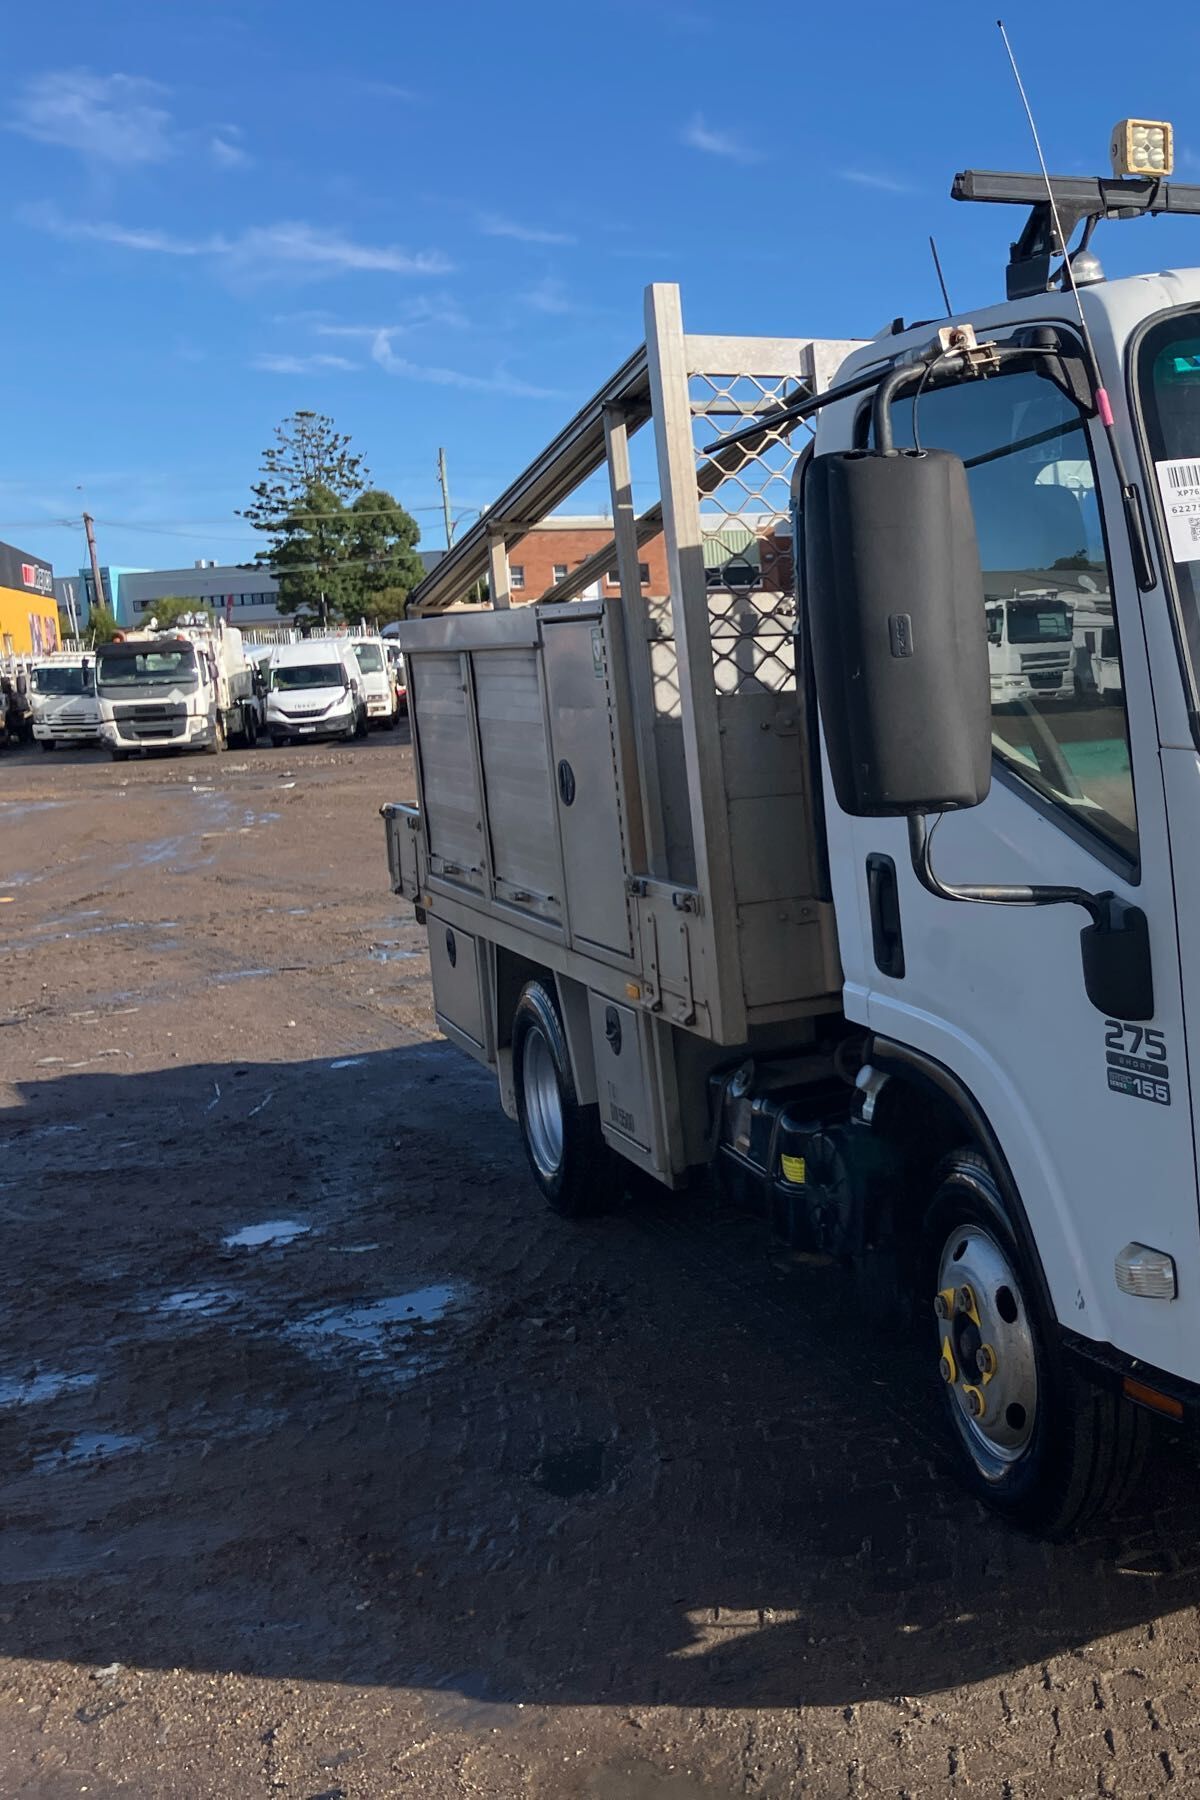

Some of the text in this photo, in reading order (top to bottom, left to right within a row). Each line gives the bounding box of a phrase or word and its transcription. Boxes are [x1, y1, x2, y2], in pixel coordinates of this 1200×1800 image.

[1104, 1020, 1166, 1061] 275
[1119, 1058, 1153, 1070] SHORT
[1132, 1078, 1168, 1102] 155
